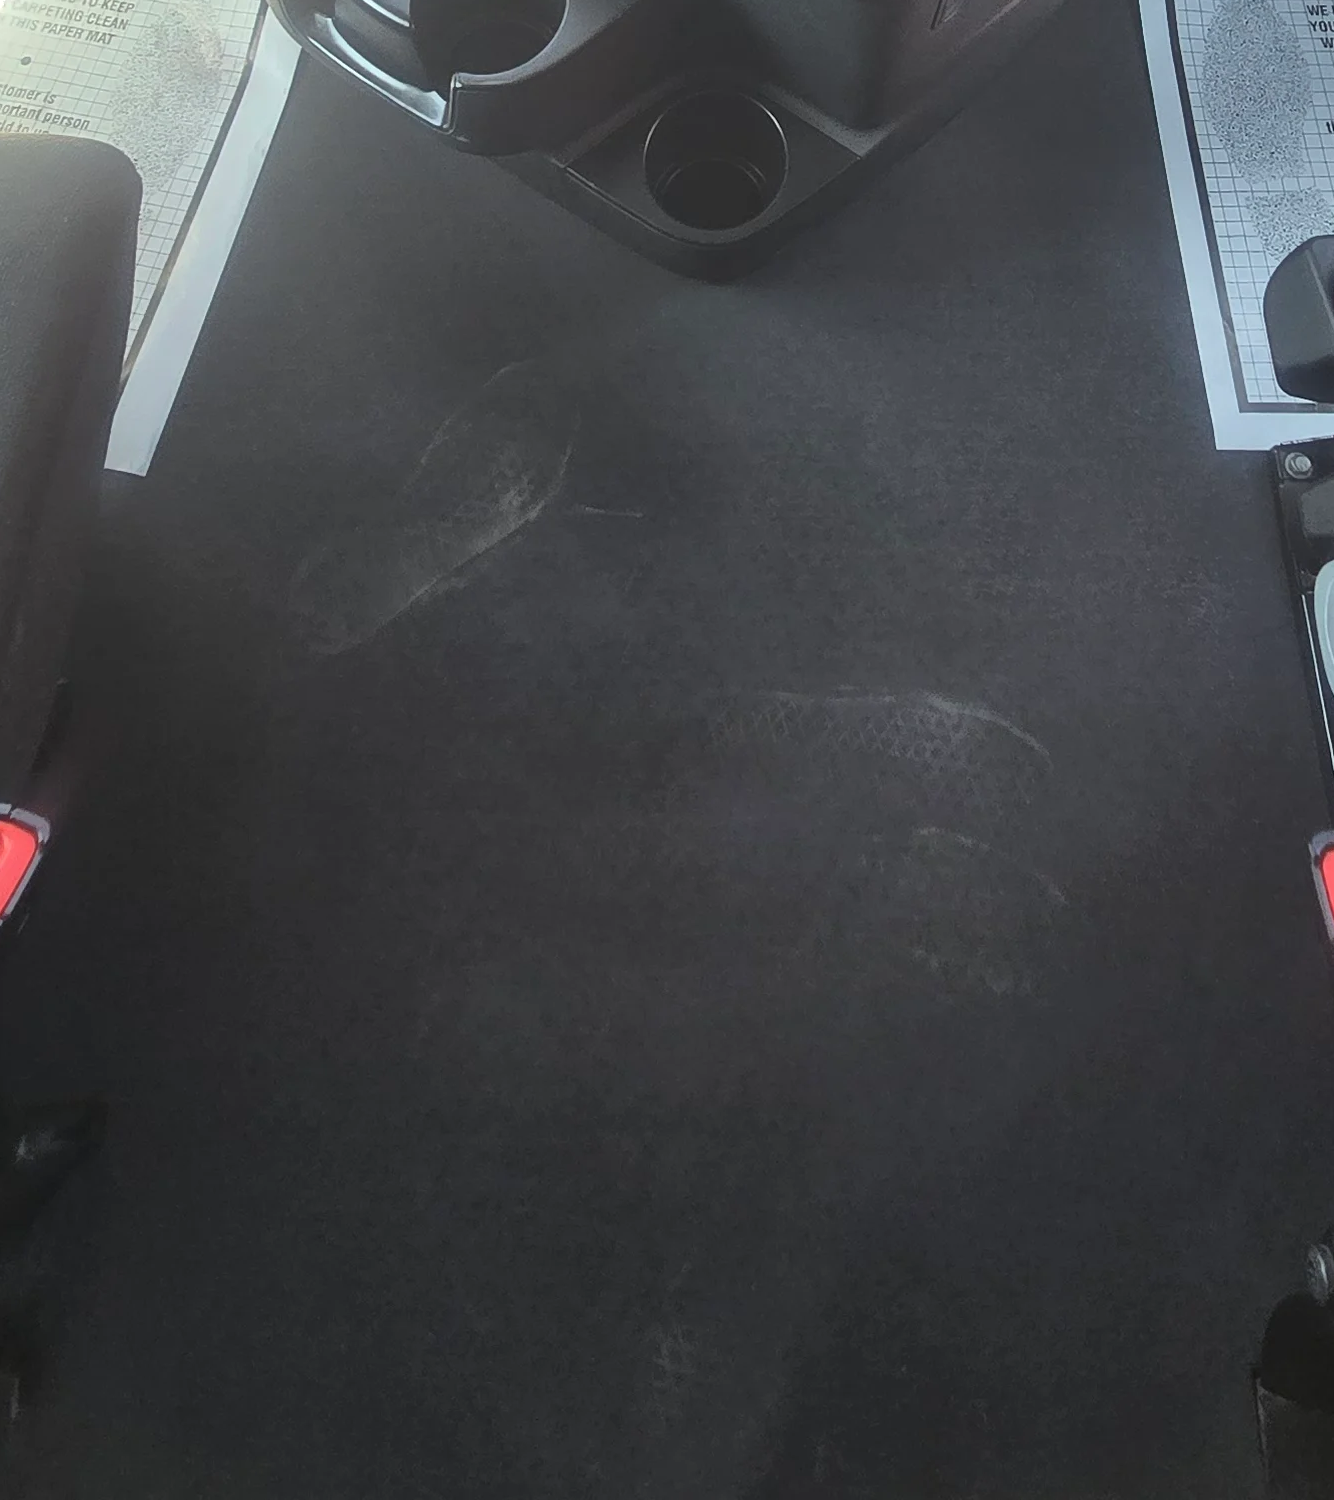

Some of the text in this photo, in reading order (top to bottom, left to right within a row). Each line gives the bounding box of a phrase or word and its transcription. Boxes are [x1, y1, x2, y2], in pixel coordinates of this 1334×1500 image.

[11, 0, 129, 30] CARPETING CLEAN
[1307, 4, 1328, 16] WE
[9, 16, 40, 31] THIS
[40, 21, 84, 39] PAPER
[85, 29, 117, 45] MAT
[42, 90, 57, 105] is
[43, 111, 90, 131] person
